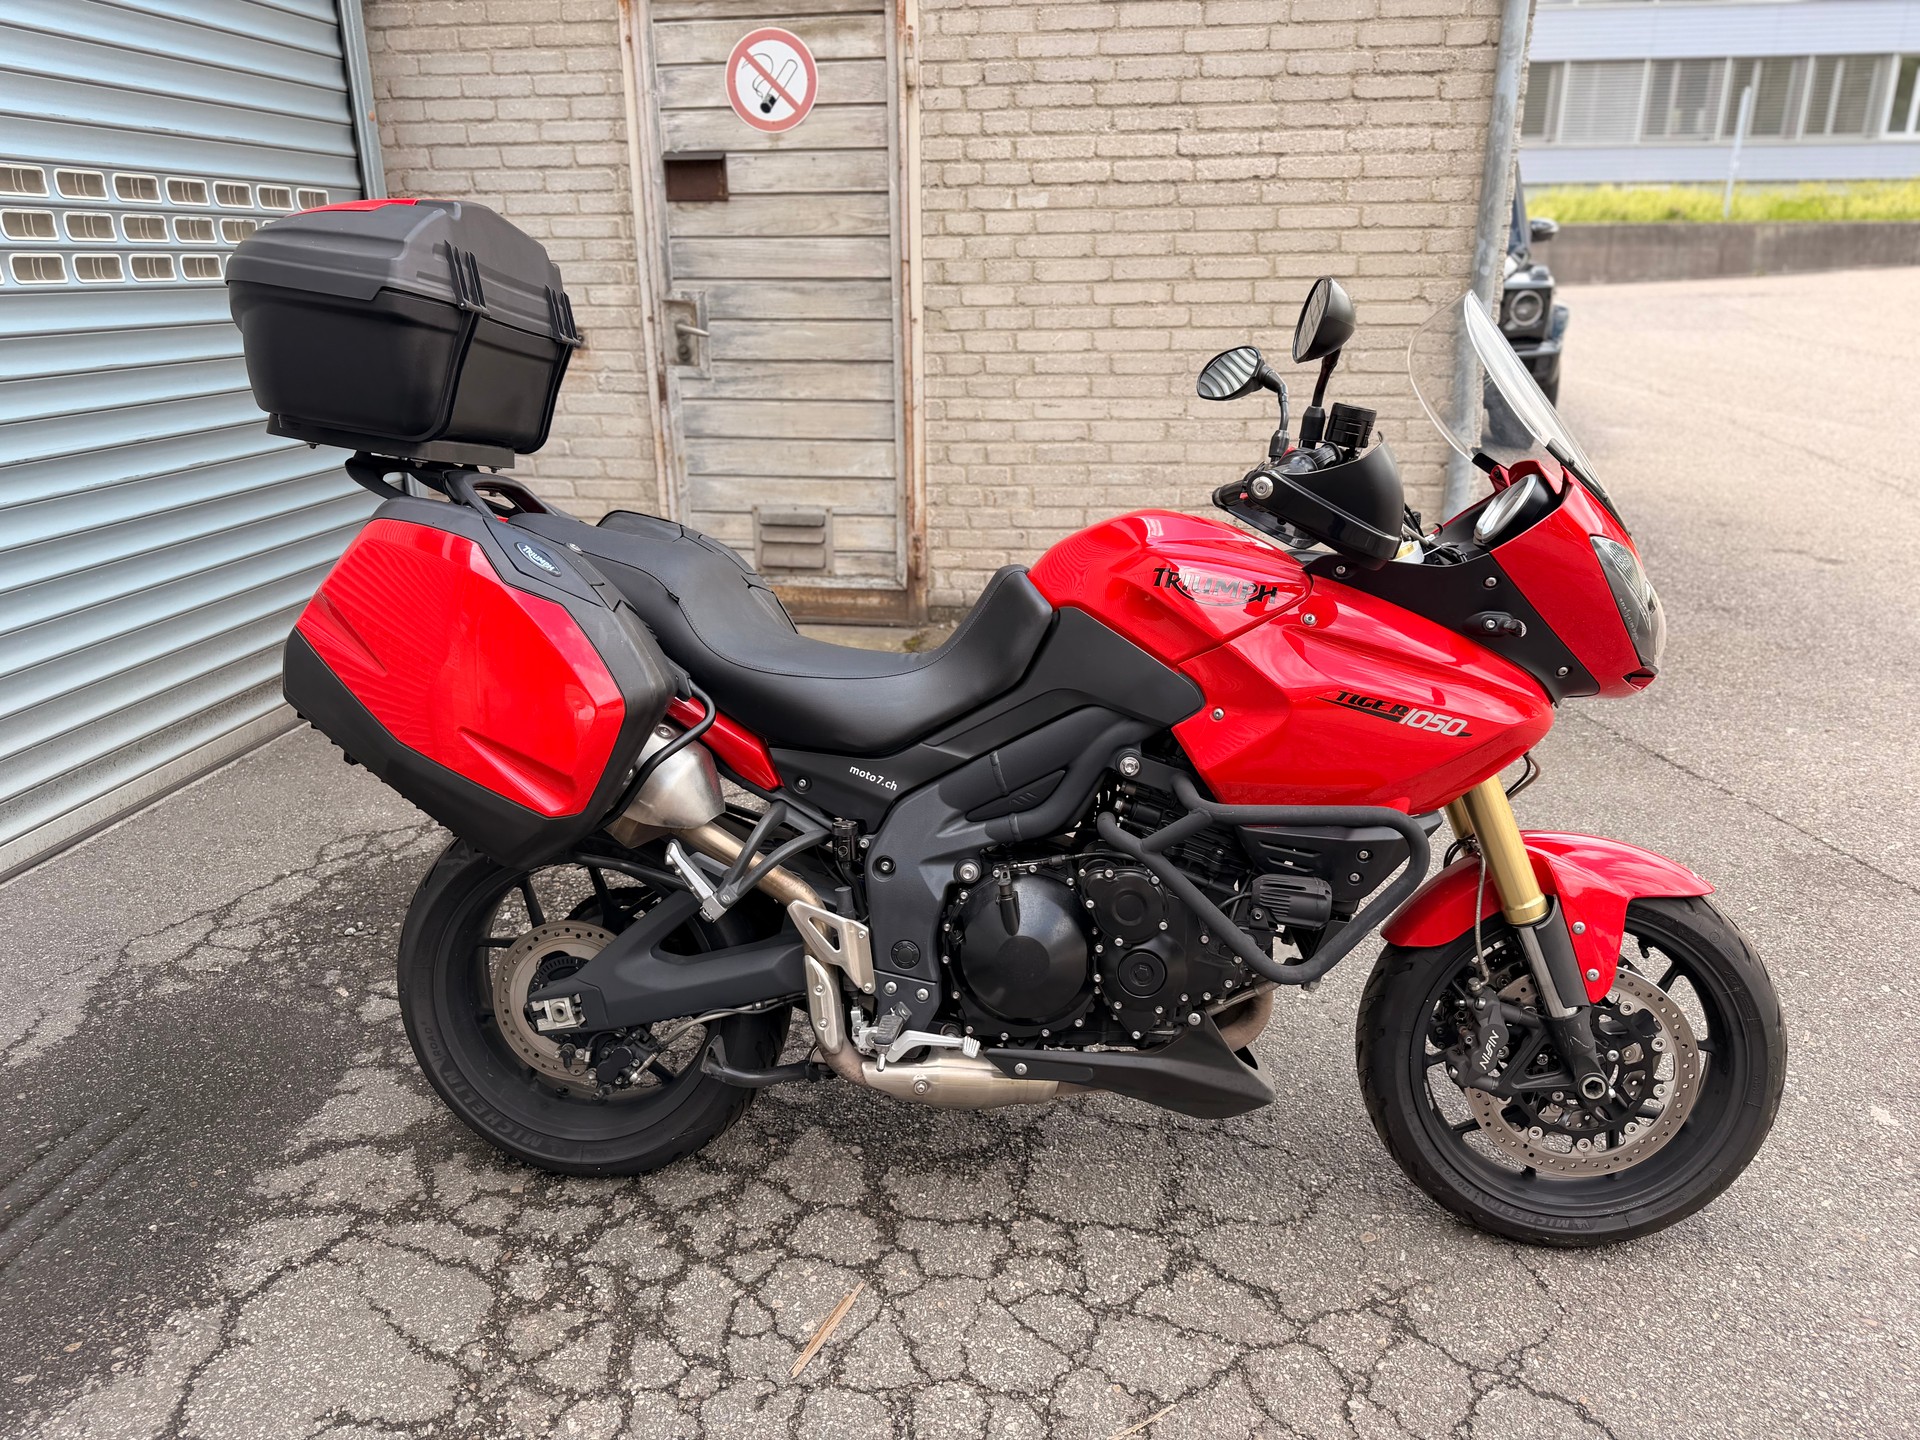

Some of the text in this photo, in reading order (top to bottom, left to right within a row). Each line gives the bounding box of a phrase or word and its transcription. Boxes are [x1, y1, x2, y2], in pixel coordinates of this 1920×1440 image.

[522, 544, 555, 571] TRIUMPH
[1153, 567, 1278, 605] TRIUMPH
[1336, 690, 1468, 736] TIGER 1050
[849, 766, 898, 791] moto7.ch
[1479, 1029, 1500, 1071] NISSIN
[442, 1069, 544, 1149] MICHELIN
[1484, 1193, 1570, 1230] MICHELIN
